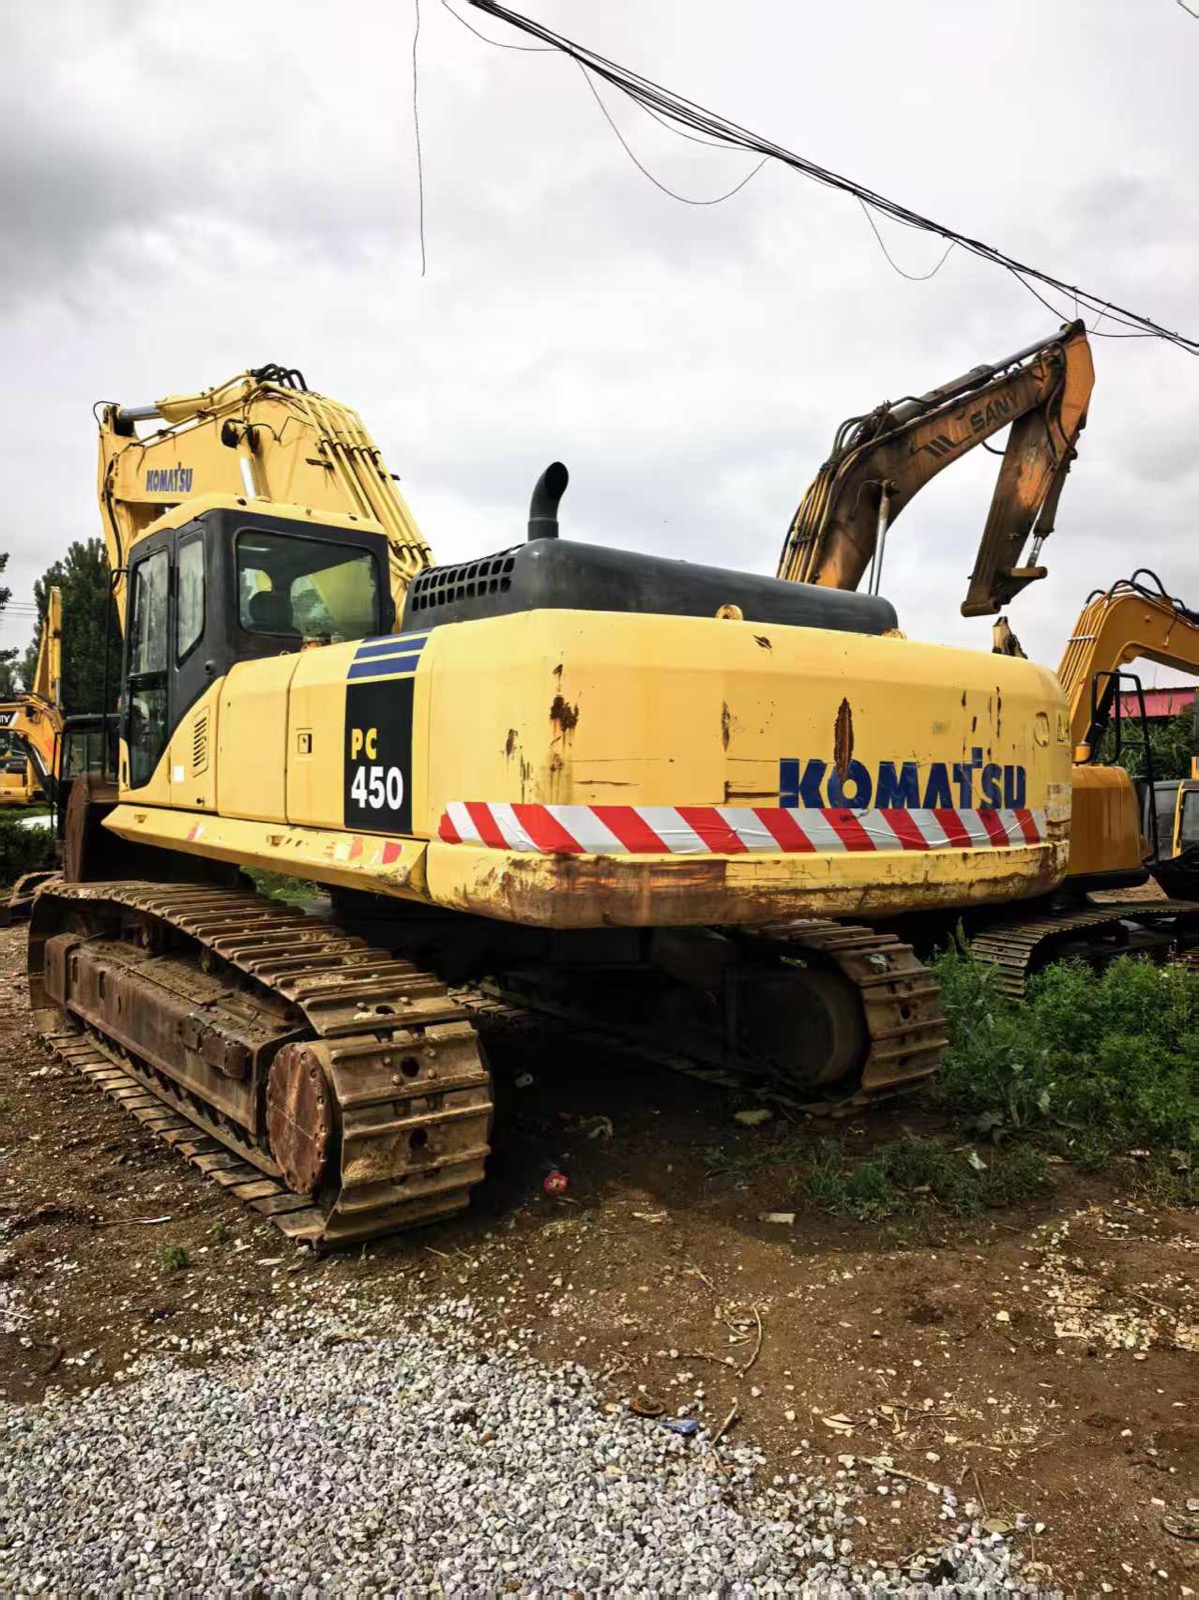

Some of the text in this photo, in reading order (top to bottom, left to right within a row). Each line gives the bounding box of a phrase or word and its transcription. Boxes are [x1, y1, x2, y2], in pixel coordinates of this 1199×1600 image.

[970, 389, 1019, 433] SANY
[146, 461, 193, 492] KOMATSU
[351, 728, 377, 760] PC
[351, 766, 404, 810] 450
[780, 747, 1027, 809] KOMATSU
